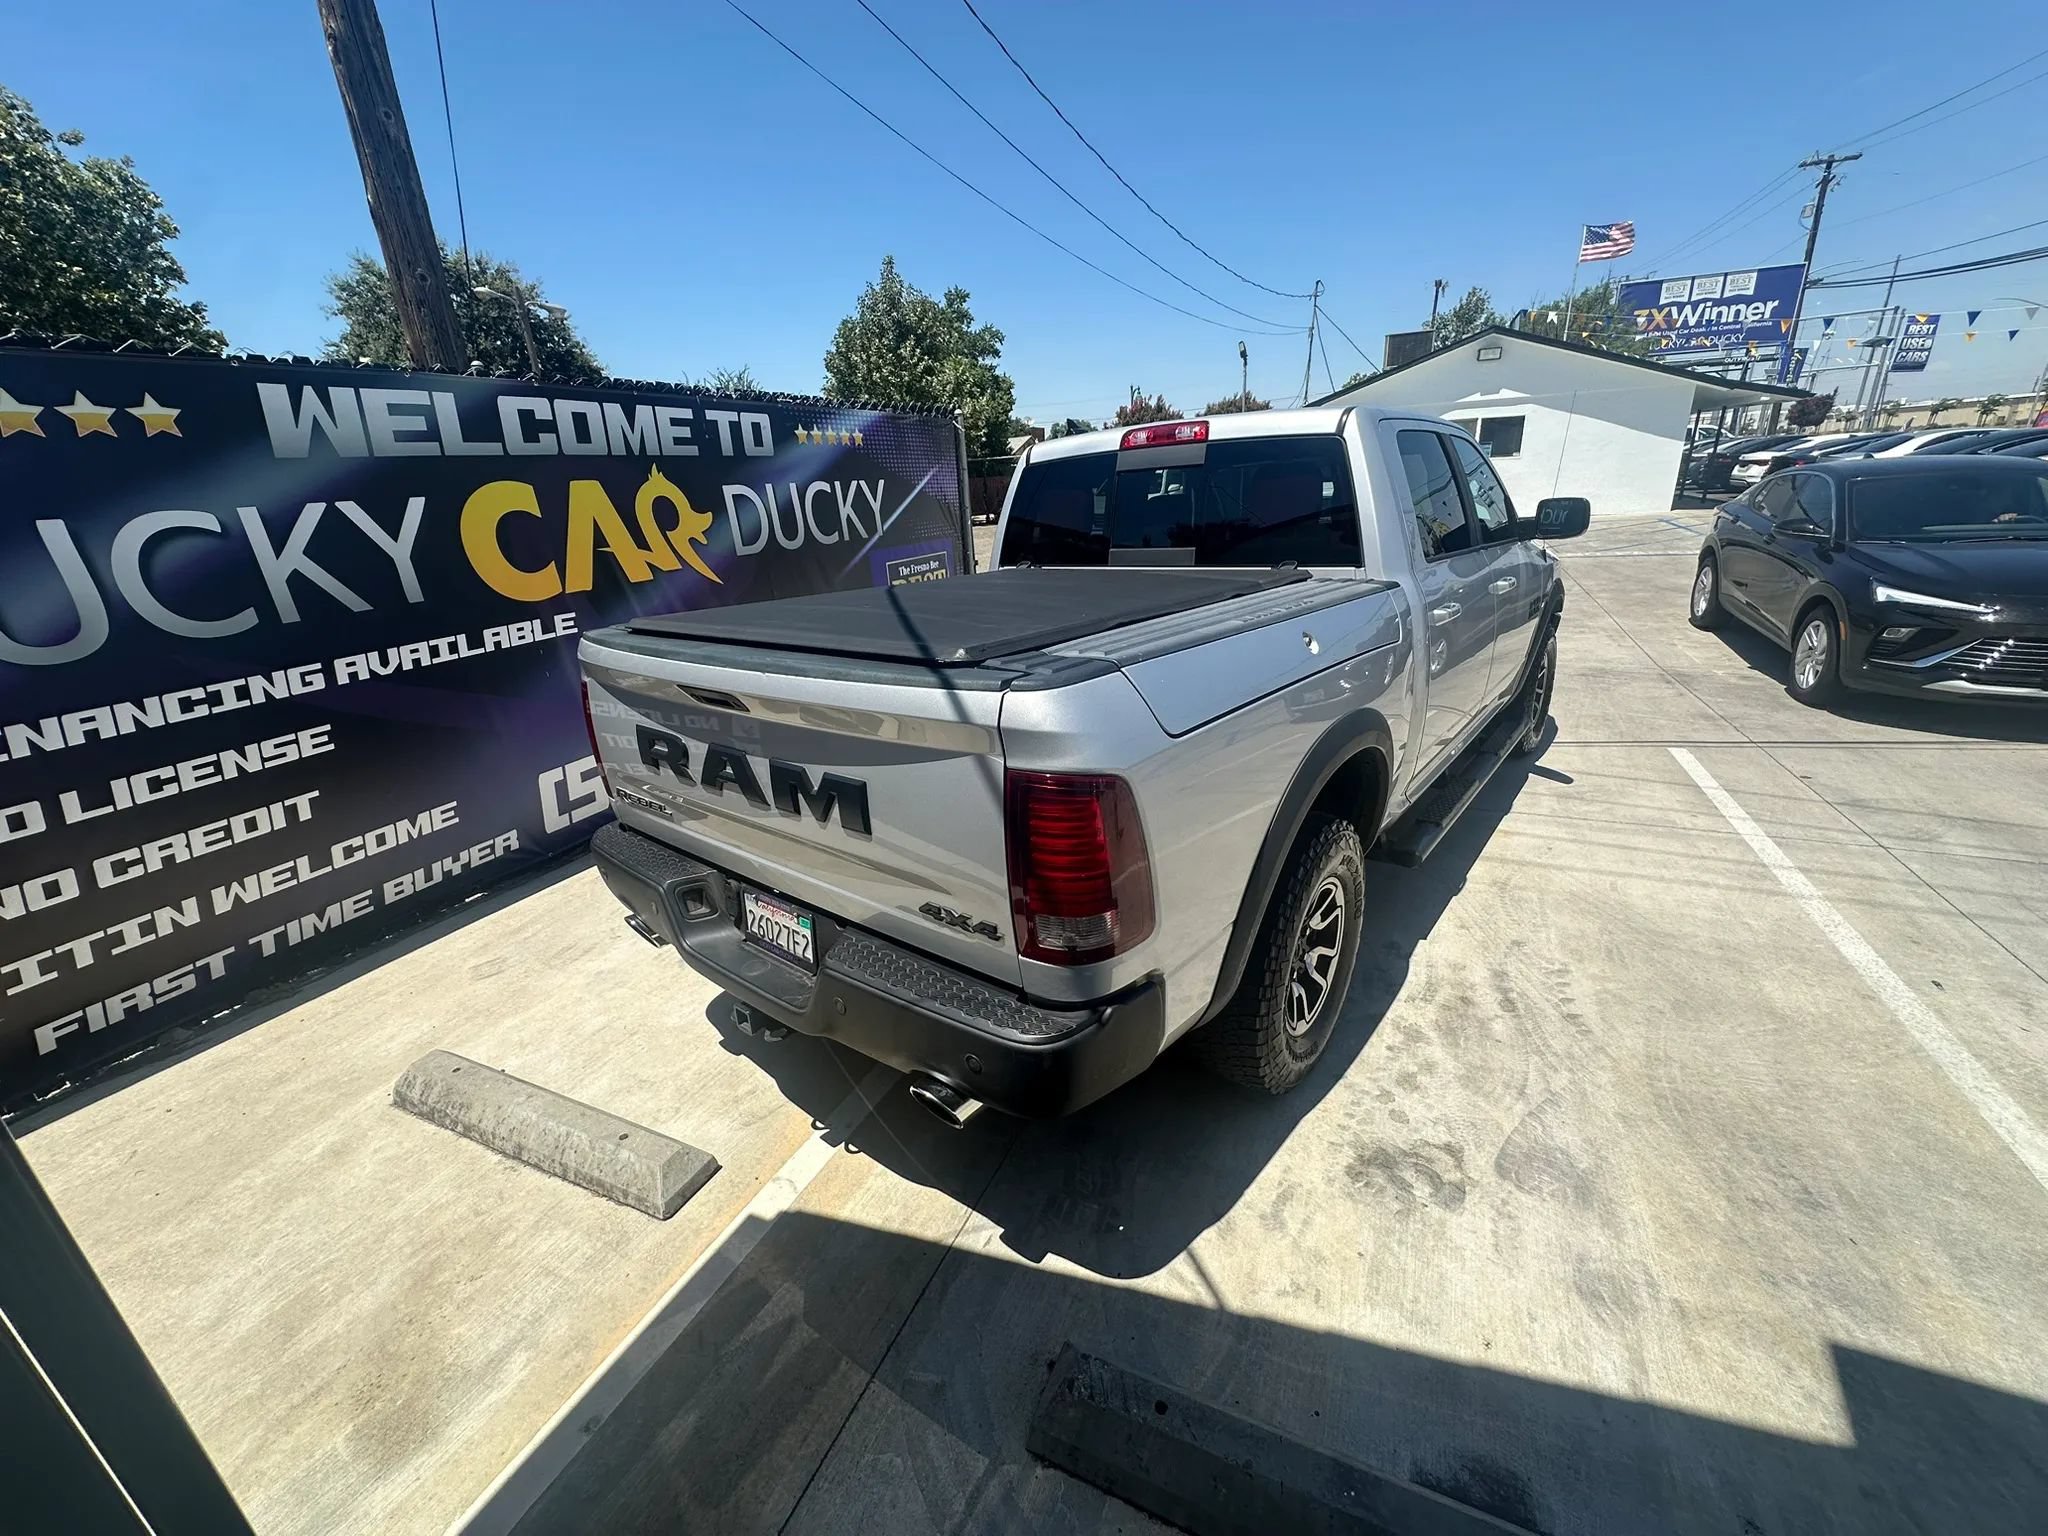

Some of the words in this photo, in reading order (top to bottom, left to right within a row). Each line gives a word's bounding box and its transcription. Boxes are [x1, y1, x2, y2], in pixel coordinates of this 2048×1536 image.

[1896, 351, 1929, 363] CARS
[1907, 324, 1936, 335] BEST
[256, 382, 700, 458] WELCOME
[705, 411, 774, 457] TO
[459, 462, 724, 602] CAR
[722, 478, 886, 556] DUCKY
[898, 565, 910, 576] The
[333, 612, 579, 686] AVAILABLE
[58, 724, 335, 825] LICENSE
[616, 786, 673, 816] REBEL
[636, 724, 873, 838] RAM
[92, 790, 320, 889] CREDIT
[0, 896, 201, 996] ITIN
[211, 801, 460, 916] WELCOME
[748, 908, 812, 961] 26027F2
[33, 946, 236, 1056] FIRST
[248, 889, 375, 958] TIME
[383, 829, 521, 905] BUYER
